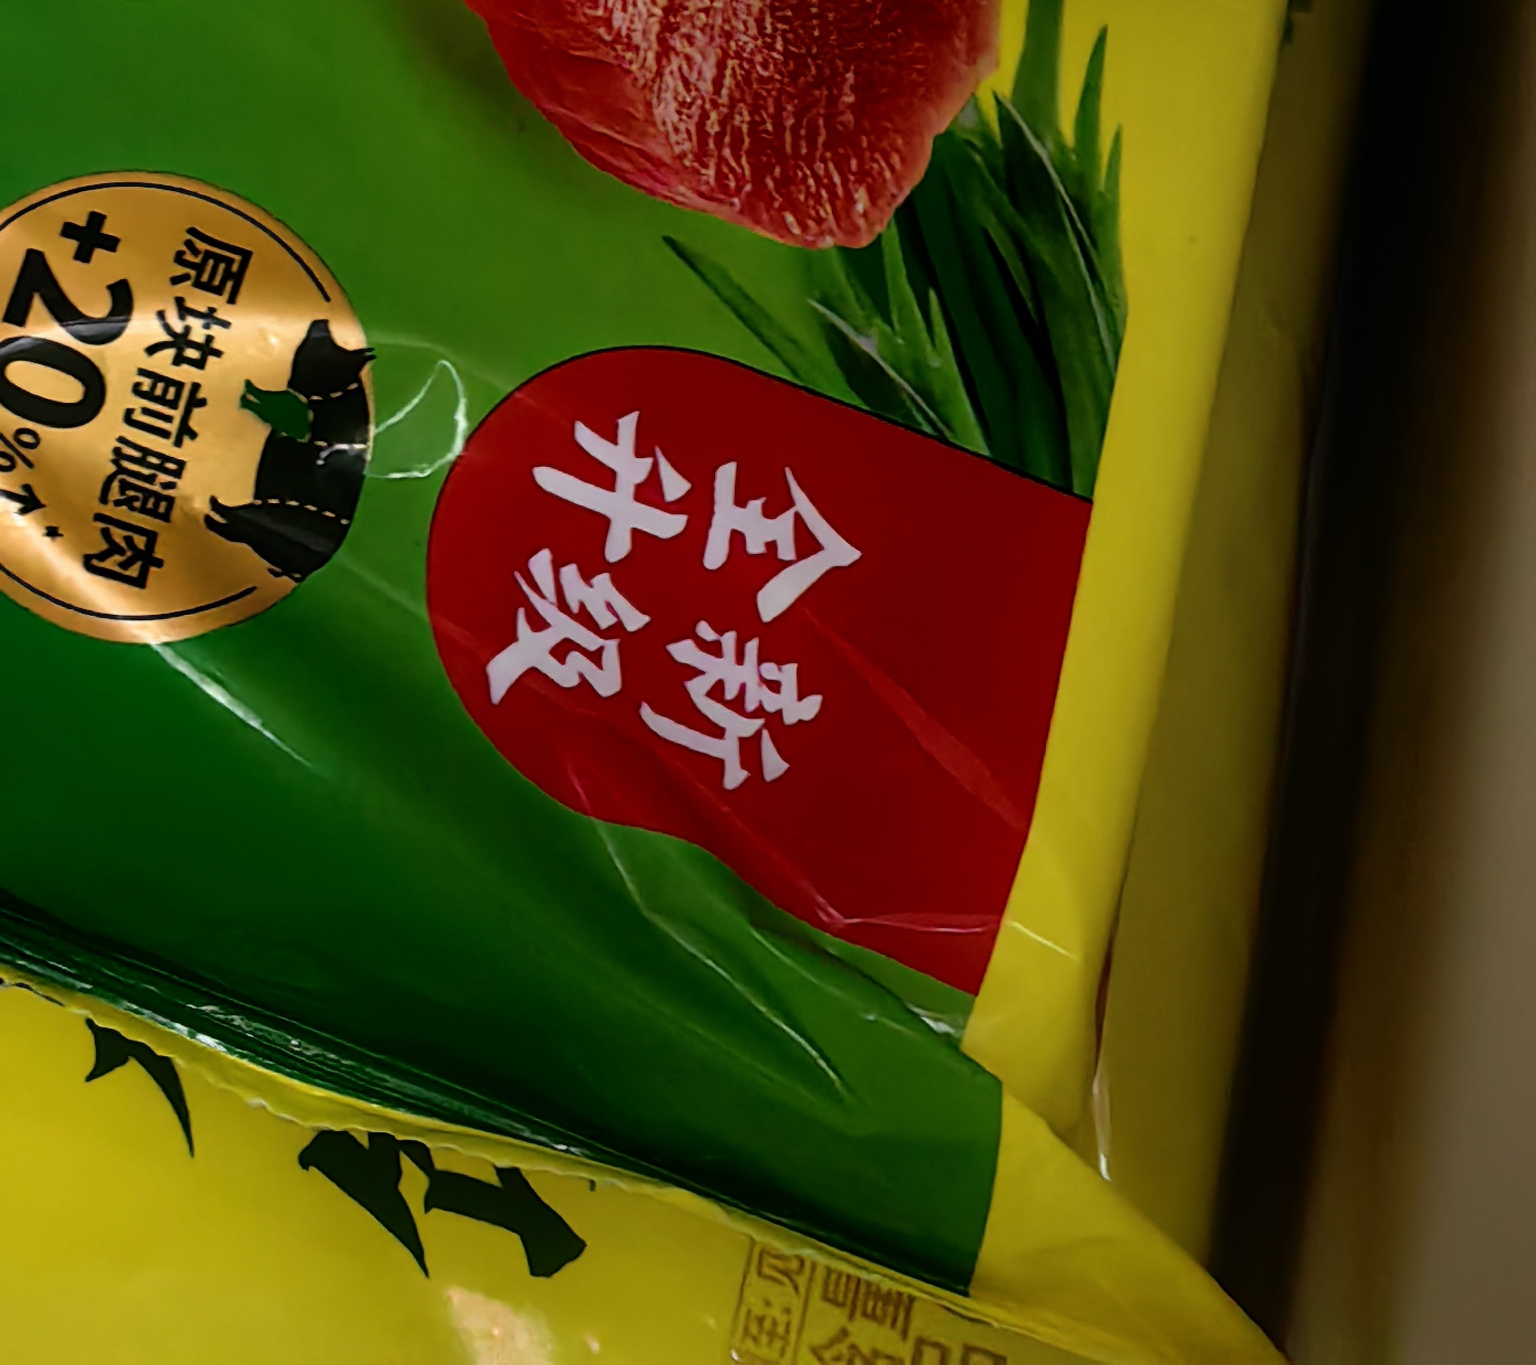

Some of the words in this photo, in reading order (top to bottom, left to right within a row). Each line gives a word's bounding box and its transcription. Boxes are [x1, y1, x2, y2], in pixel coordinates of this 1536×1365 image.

[82, 225, 253, 589] 原块前腿肉
[485, 410, 692, 705] 升级
[639, 461, 863, 791] 全新
